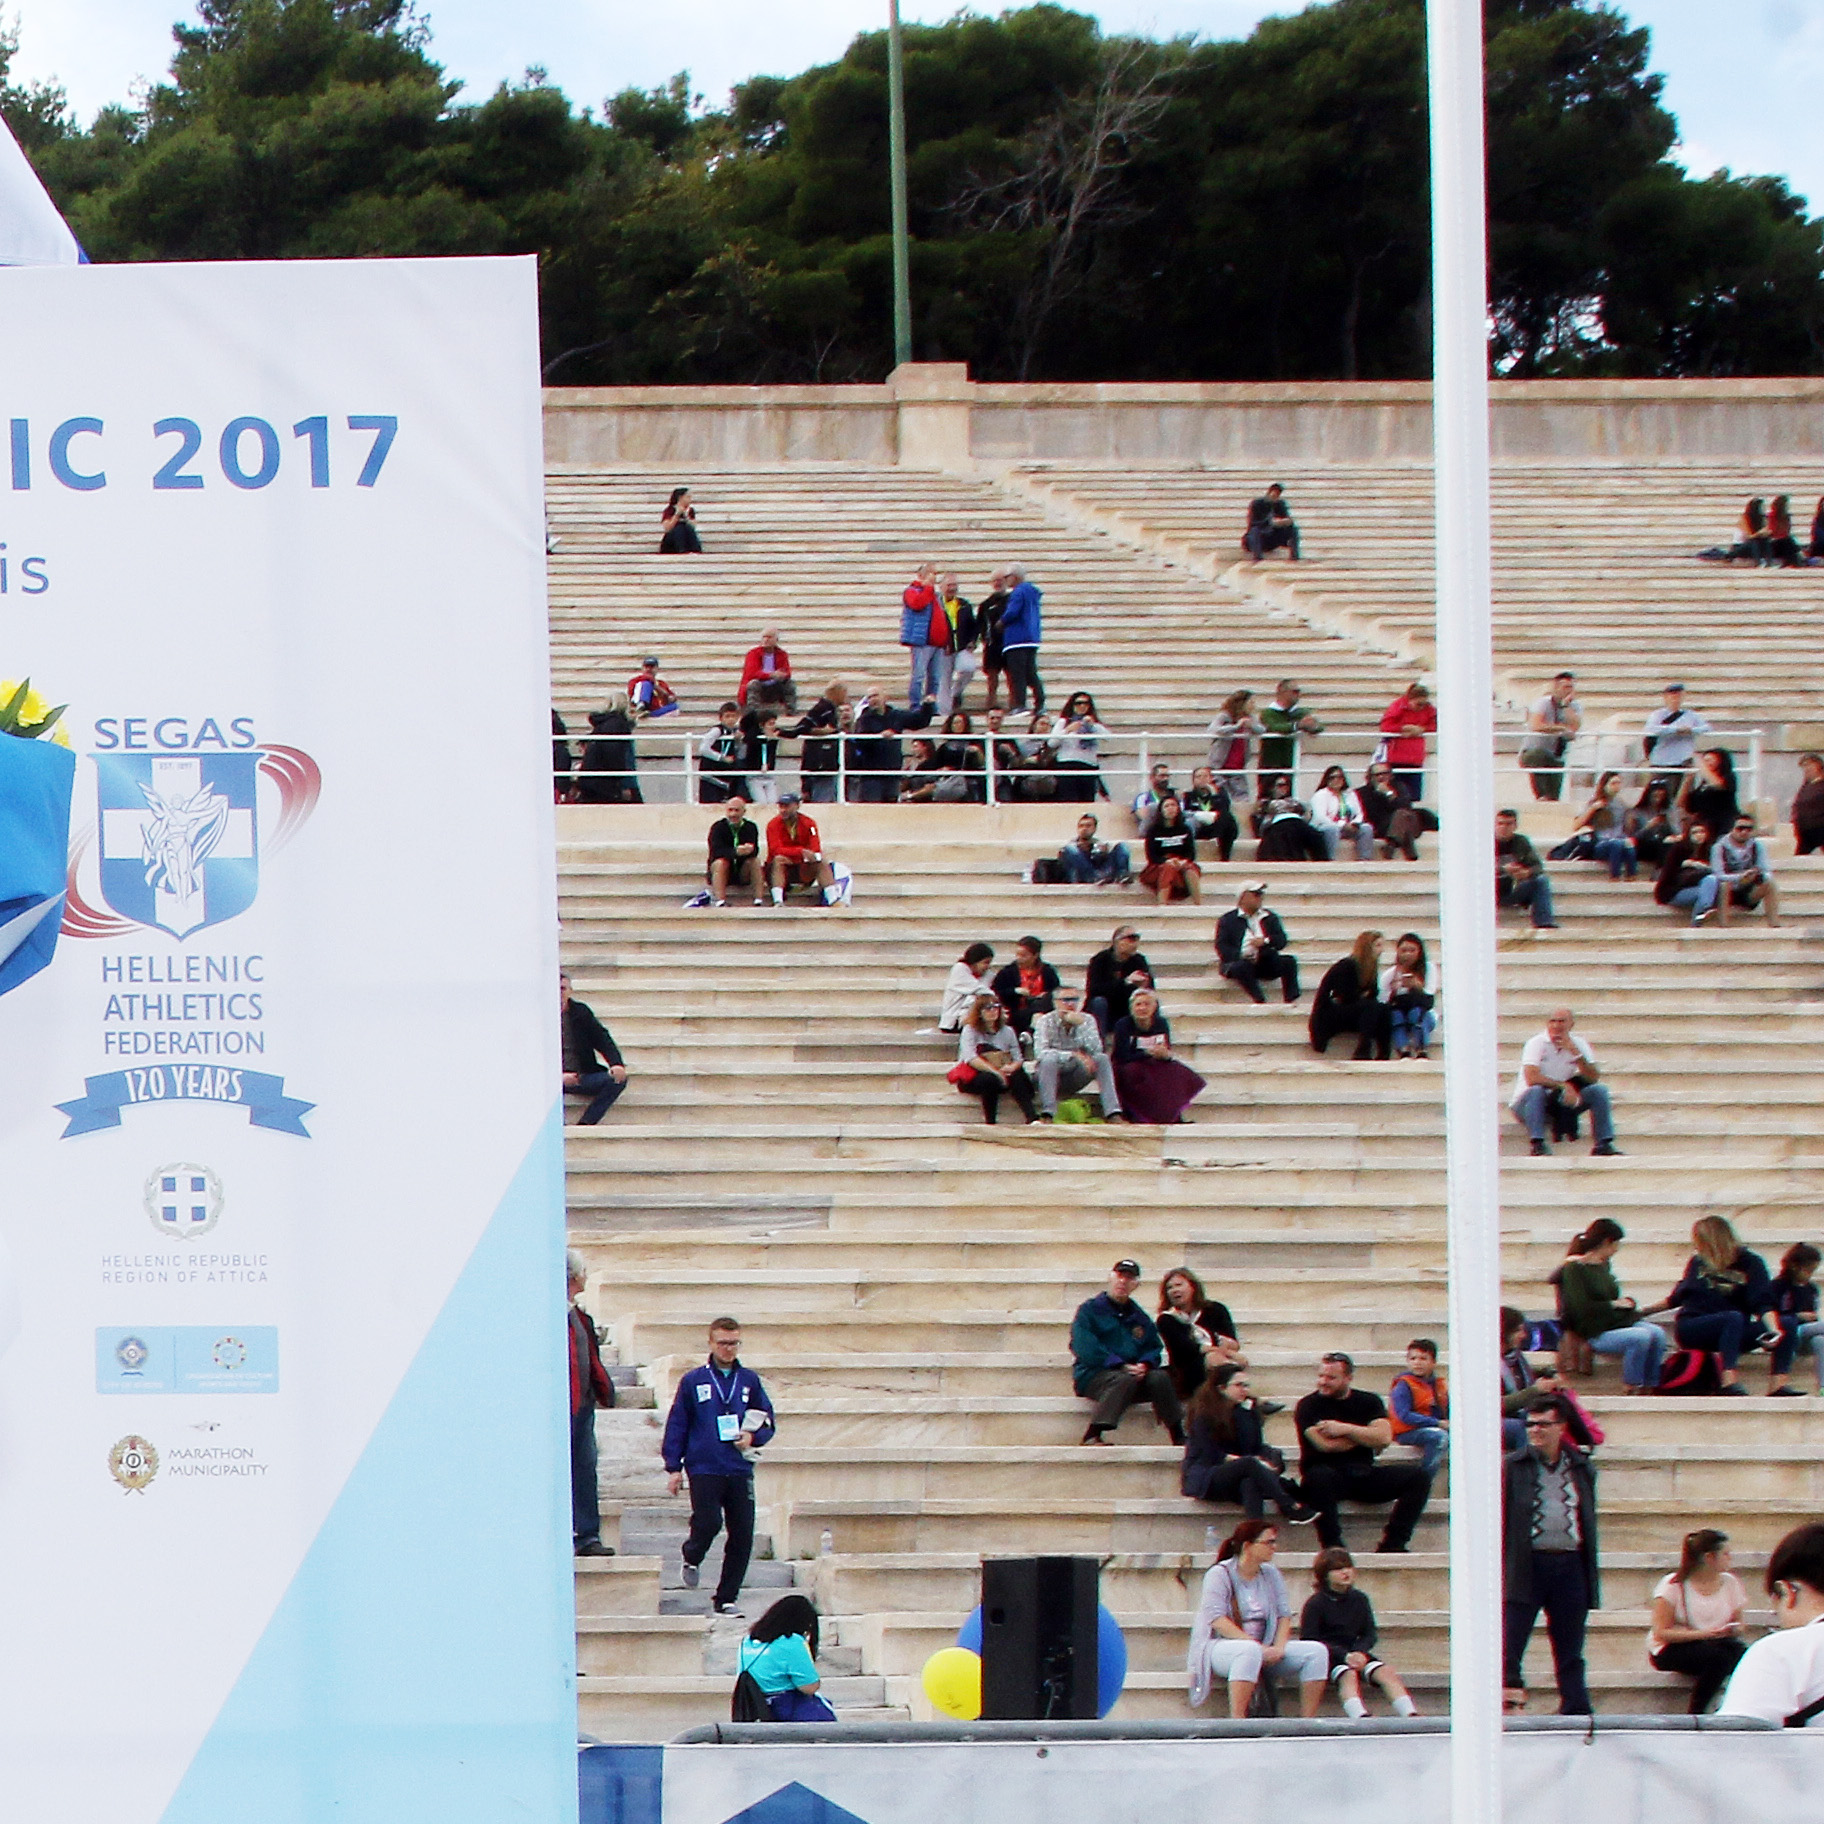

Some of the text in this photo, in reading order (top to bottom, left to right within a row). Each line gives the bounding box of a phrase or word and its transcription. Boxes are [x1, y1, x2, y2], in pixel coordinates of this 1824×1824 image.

[153, 414, 399, 489] 2017
[95, 716, 256, 749] SEGAS
[102, 955, 264, 983] HELLENIC
[103, 993, 263, 1021] ATHLETICS
[104, 1031, 265, 1054] FEDERATION
[125, 1066, 243, 1103] 120 YEARS
[102, 1254, 268, 1267] HELLENIC REPUBLIC
[102, 1271, 268, 1283] REGION OF ATTICA
[168, 1448, 253, 1460] MARATHON
[168, 1464, 269, 1477] MUNICIPALITY
